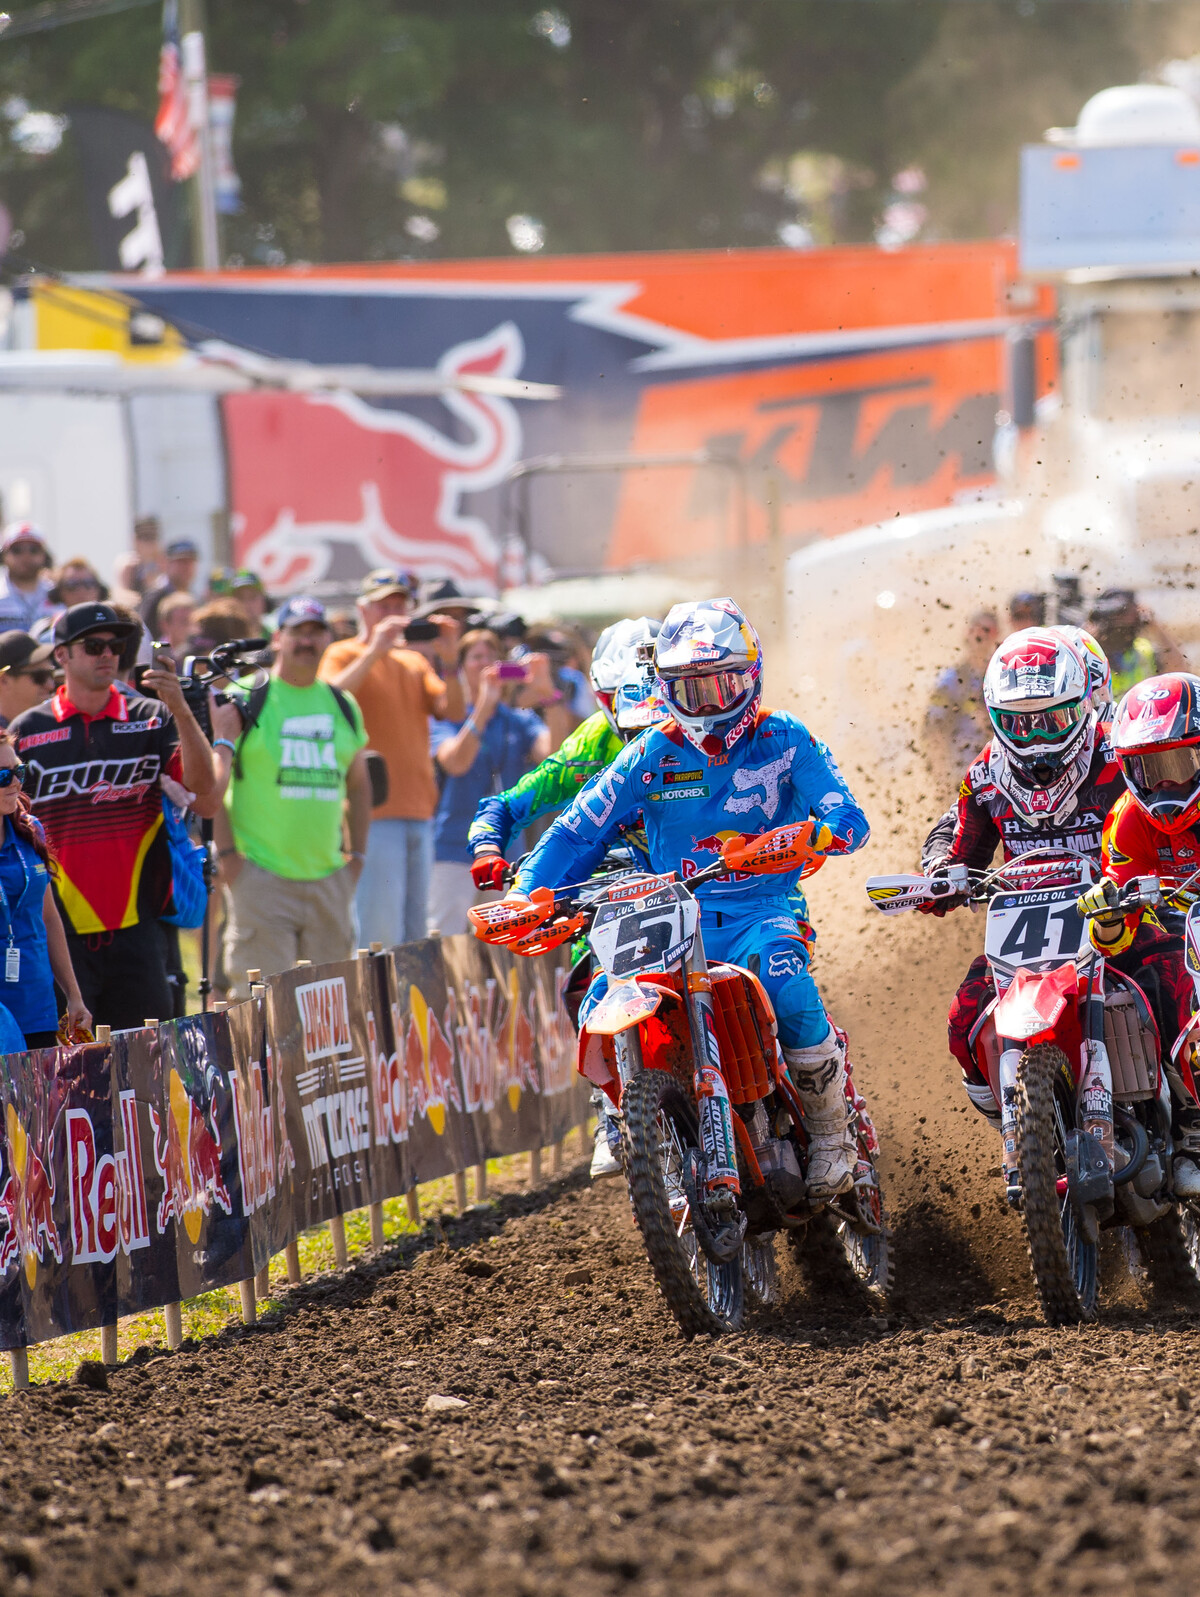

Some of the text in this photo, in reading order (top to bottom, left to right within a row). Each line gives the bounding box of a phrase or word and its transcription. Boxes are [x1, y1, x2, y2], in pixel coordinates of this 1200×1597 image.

[661, 787, 705, 801] MOTOREX
[1005, 838, 1064, 856] MUSCLE
[740, 851, 797, 868] ACERBIS
[646, 896, 662, 907] OIL
[1018, 891, 1066, 905] LUCAS OIL
[484, 914, 540, 936] ACERBIS
[999, 902, 1085, 961] 41
[516, 925, 570, 947] ACERBIS
[612, 903, 677, 977] 5
[667, 939, 692, 963] DUNGEY
[1187, 947, 1200, 971] GEICO
[1083, 1090, 1112, 1103] MUSCLE
[1086, 1101, 1109, 1113] MILK
